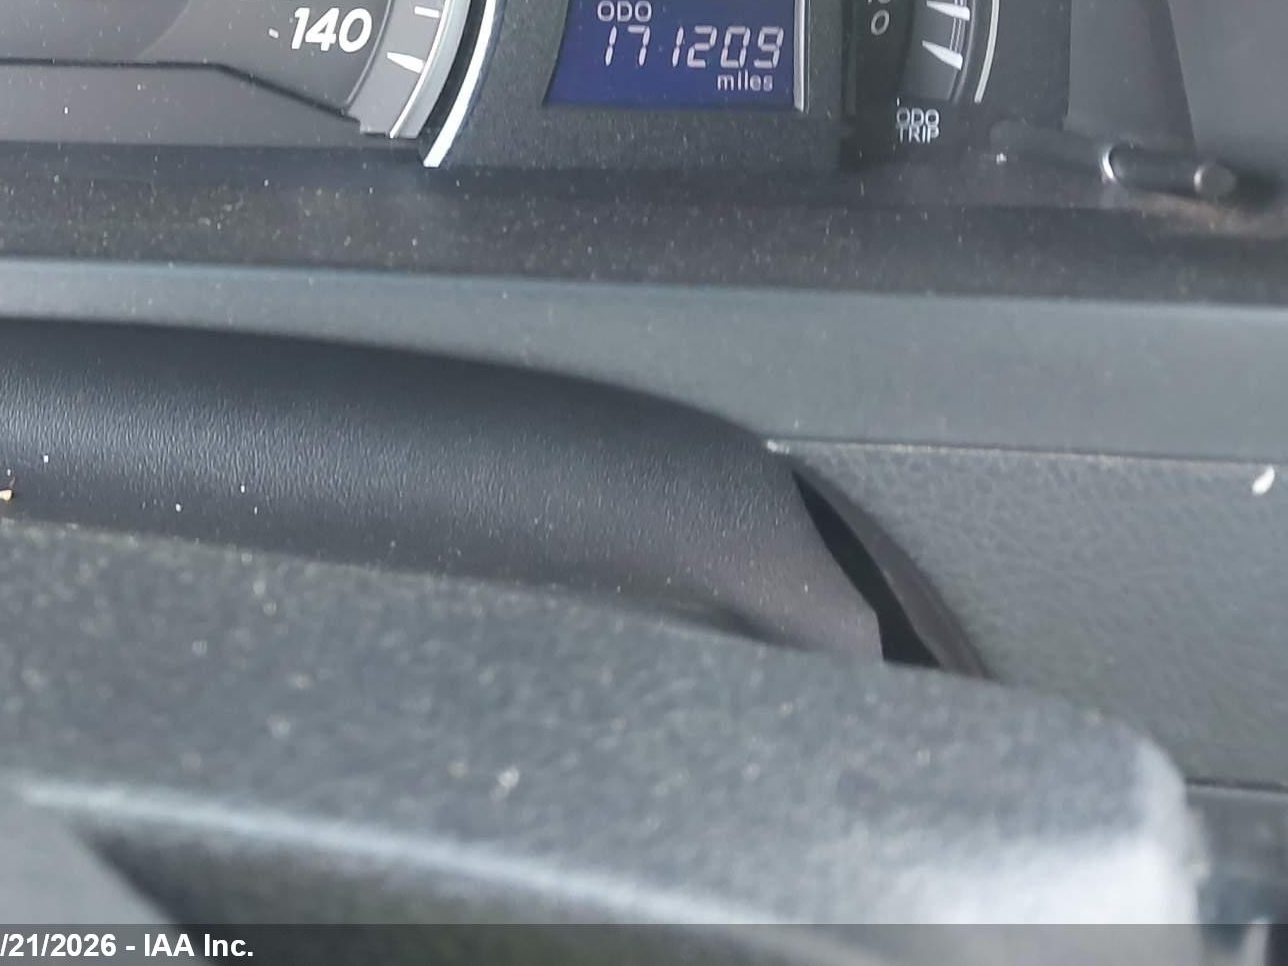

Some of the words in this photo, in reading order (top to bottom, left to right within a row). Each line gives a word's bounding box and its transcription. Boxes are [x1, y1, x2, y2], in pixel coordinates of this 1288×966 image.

[598, 1, 651, 21] ODO
[292, 8, 371, 52] 140
[871, 10, 889, 34] 0
[606, 26, 783, 68] 171209
[718, 71, 772, 90] miles
[896, 108, 940, 126] ODO
[897, 124, 940, 143] TRIP
